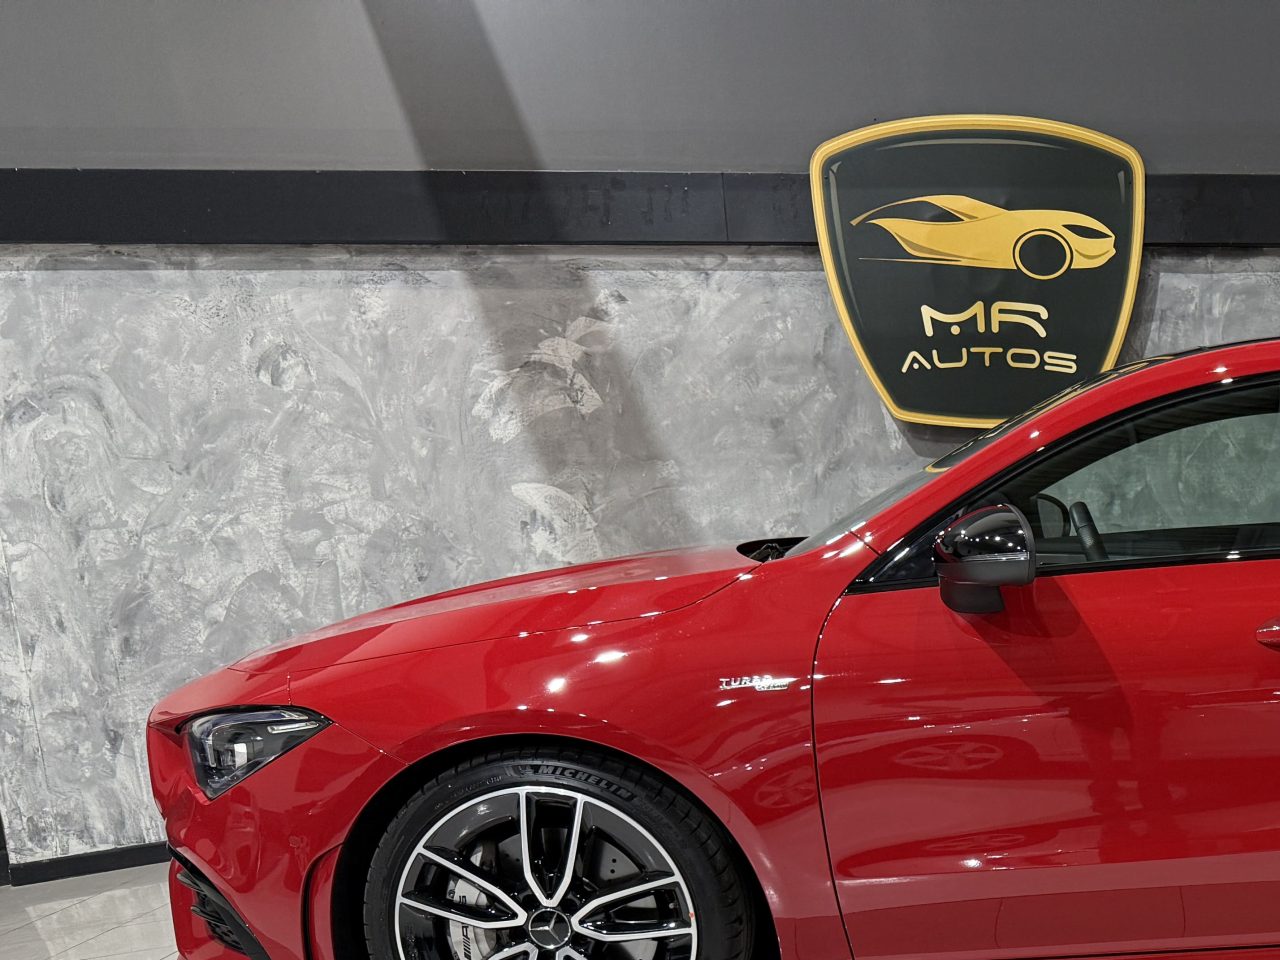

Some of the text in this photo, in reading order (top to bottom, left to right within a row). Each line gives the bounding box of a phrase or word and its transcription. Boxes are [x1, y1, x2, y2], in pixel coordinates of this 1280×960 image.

[920, 300, 1049, 338] MR
[901, 347, 1078, 374] AUTOS
[536, 763, 637, 802] MICHELIN
